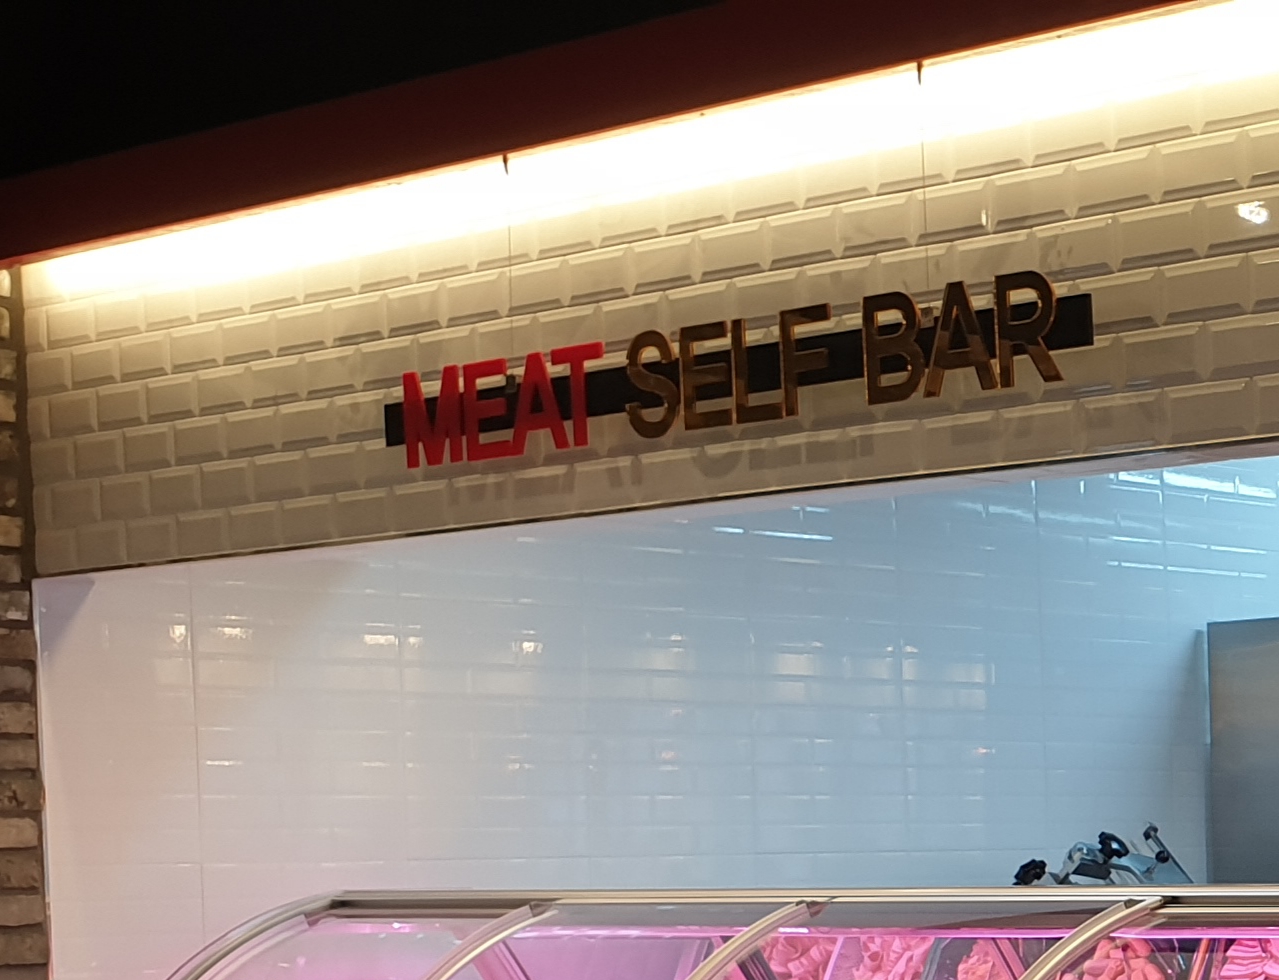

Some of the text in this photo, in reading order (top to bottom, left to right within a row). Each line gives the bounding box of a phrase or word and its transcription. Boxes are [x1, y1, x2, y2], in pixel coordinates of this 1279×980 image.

[402, 270, 1063, 469] MEAT SELF BAR
